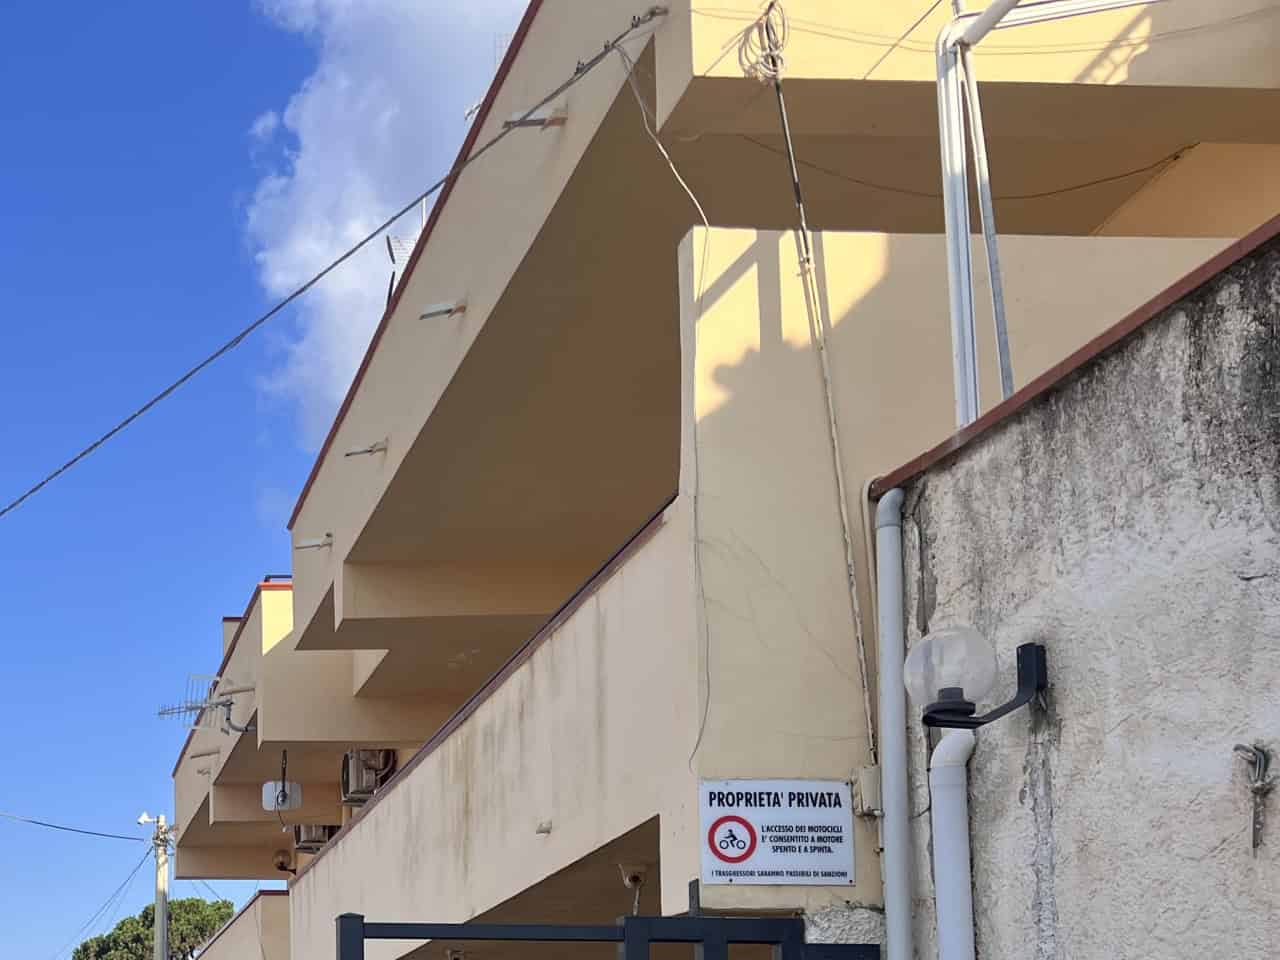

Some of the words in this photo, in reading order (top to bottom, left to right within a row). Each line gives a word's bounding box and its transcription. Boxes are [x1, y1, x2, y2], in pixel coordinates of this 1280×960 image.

[709, 791, 784, 808] PROPRIETA'
[788, 791, 842, 808] PRIVATA
[761, 825, 794, 833] L'ACCESSO
[795, 825, 806, 833] DEI
[808, 825, 843, 833] MOTOCICLI
[769, 835, 809, 843] CONSENTITO
[811, 835, 816, 843] A
[817, 835, 843, 843] MOTORE
[772, 845, 797, 853] SPENTO
